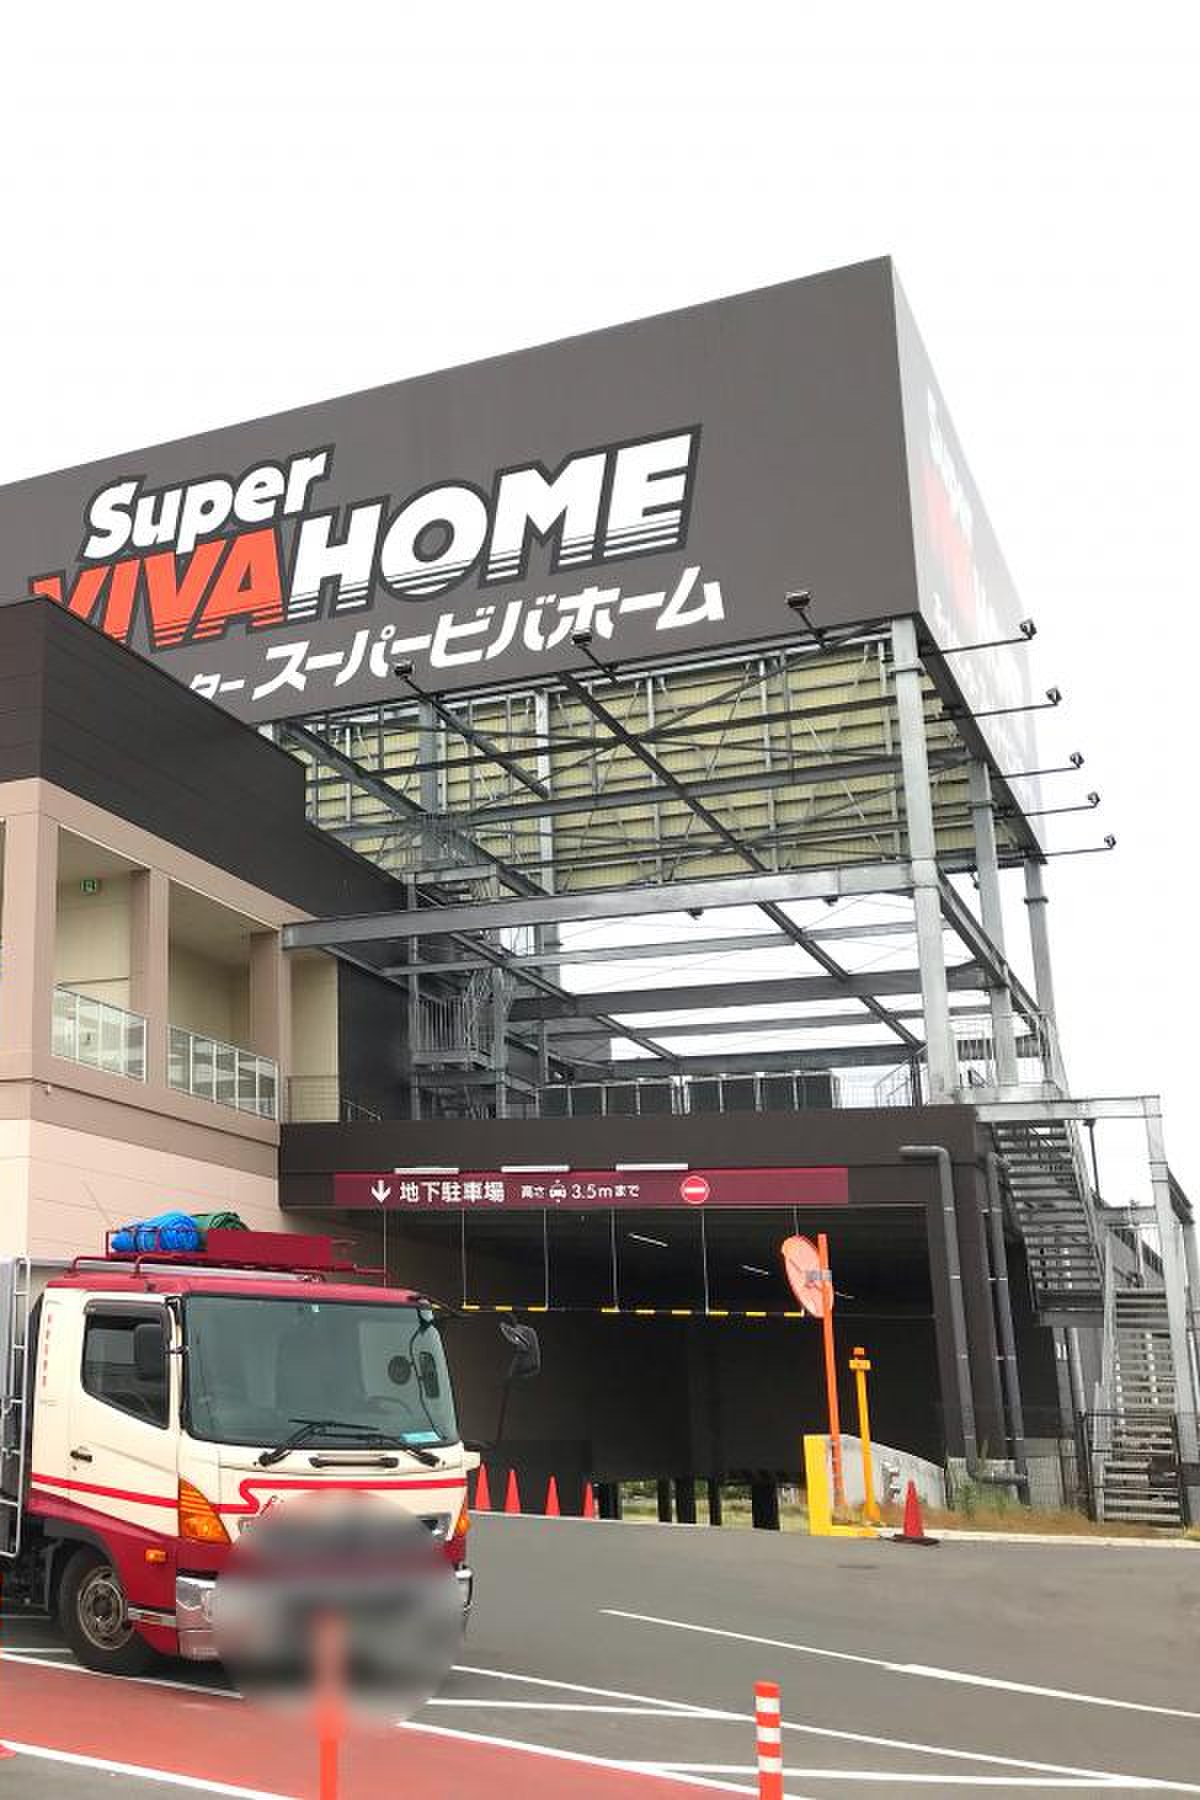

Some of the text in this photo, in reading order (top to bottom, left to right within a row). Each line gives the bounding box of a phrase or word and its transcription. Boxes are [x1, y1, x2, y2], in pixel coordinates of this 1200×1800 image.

[82, 451, 329, 560] Super
[253, 566, 726, 701] スーパービバホーム
[400, 1181, 505, 1203] 地下駐車場
[520, 1184, 545, 1200] 高さ
